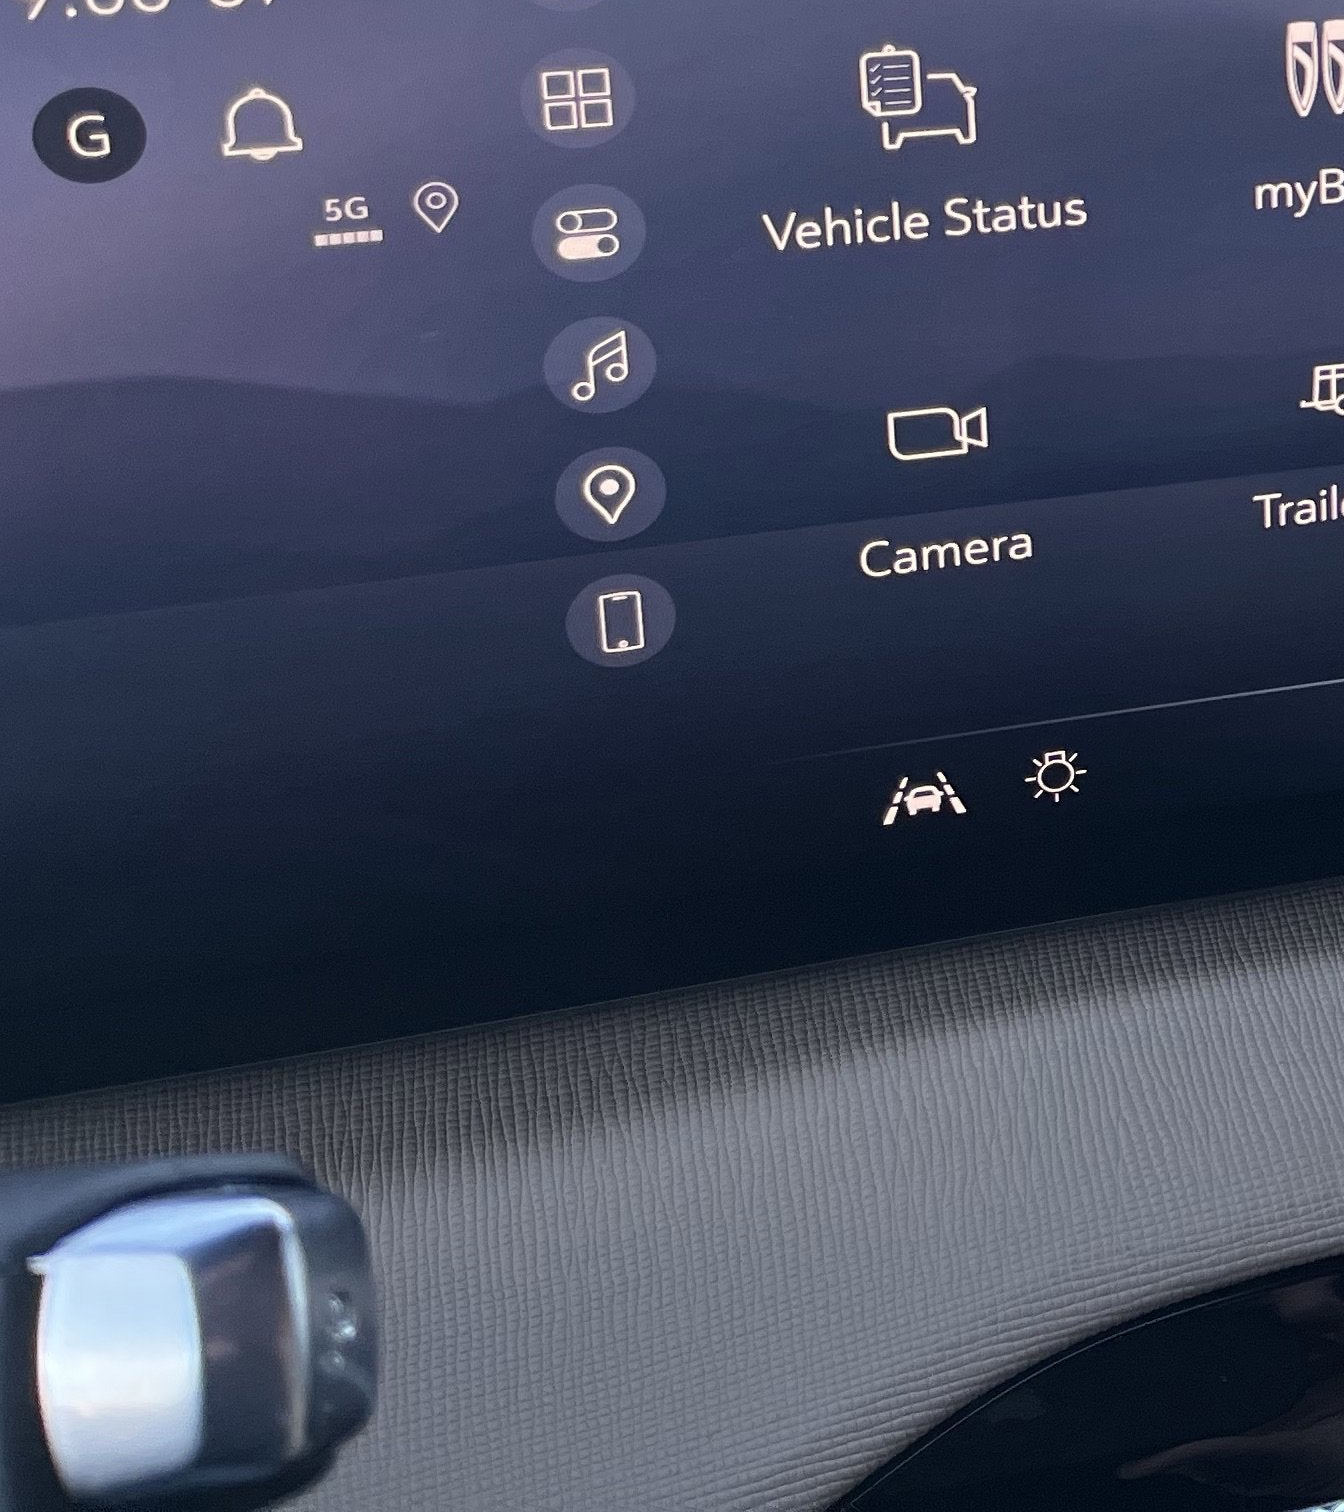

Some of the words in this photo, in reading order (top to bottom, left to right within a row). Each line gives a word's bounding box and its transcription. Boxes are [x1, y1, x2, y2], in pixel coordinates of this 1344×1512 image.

[67, 114, 111, 159] G
[325, 196, 369, 222] 5G
[761, 200, 930, 251] Vehicle
[944, 196, 1088, 236] Status
[859, 533, 1033, 577] Camera
